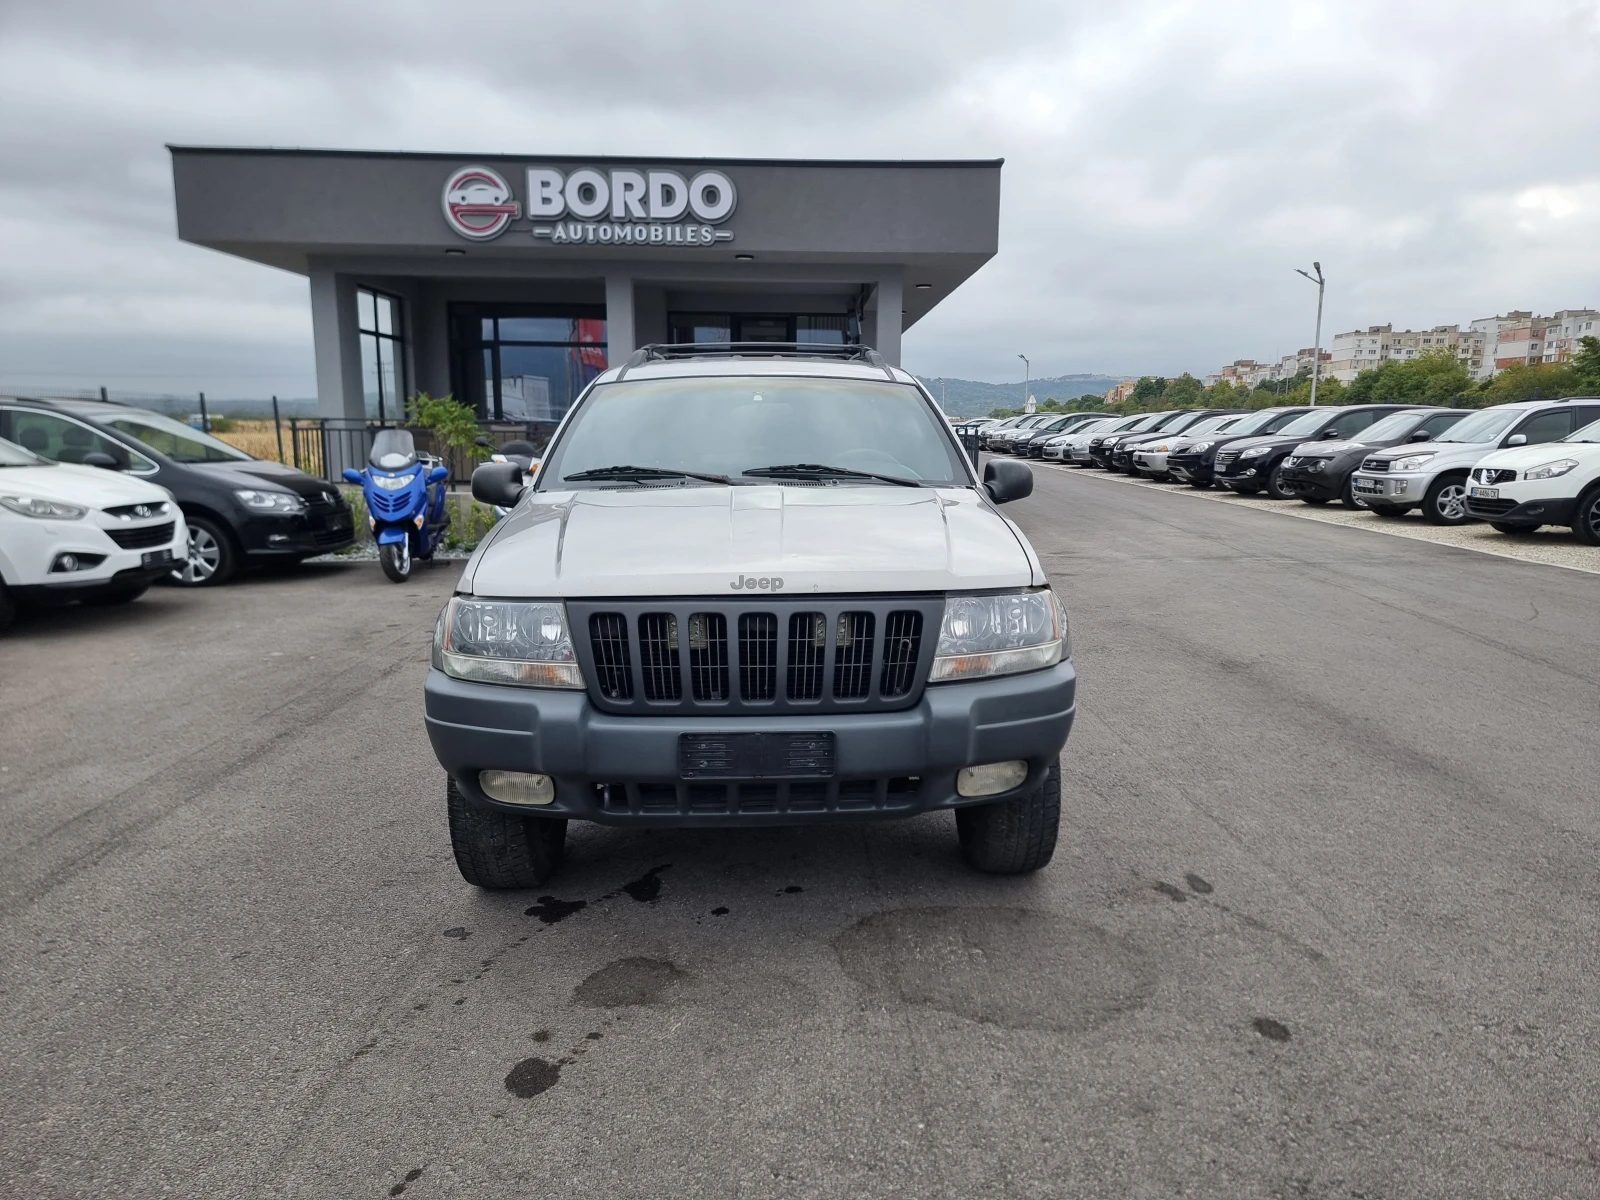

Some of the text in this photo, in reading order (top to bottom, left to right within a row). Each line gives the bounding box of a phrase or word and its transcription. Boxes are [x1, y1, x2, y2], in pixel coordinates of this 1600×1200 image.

[528, 169, 733, 219] BORDO
[553, 223, 713, 243] AUTOMOBILES
[729, 574, 784, 592] Jeep
